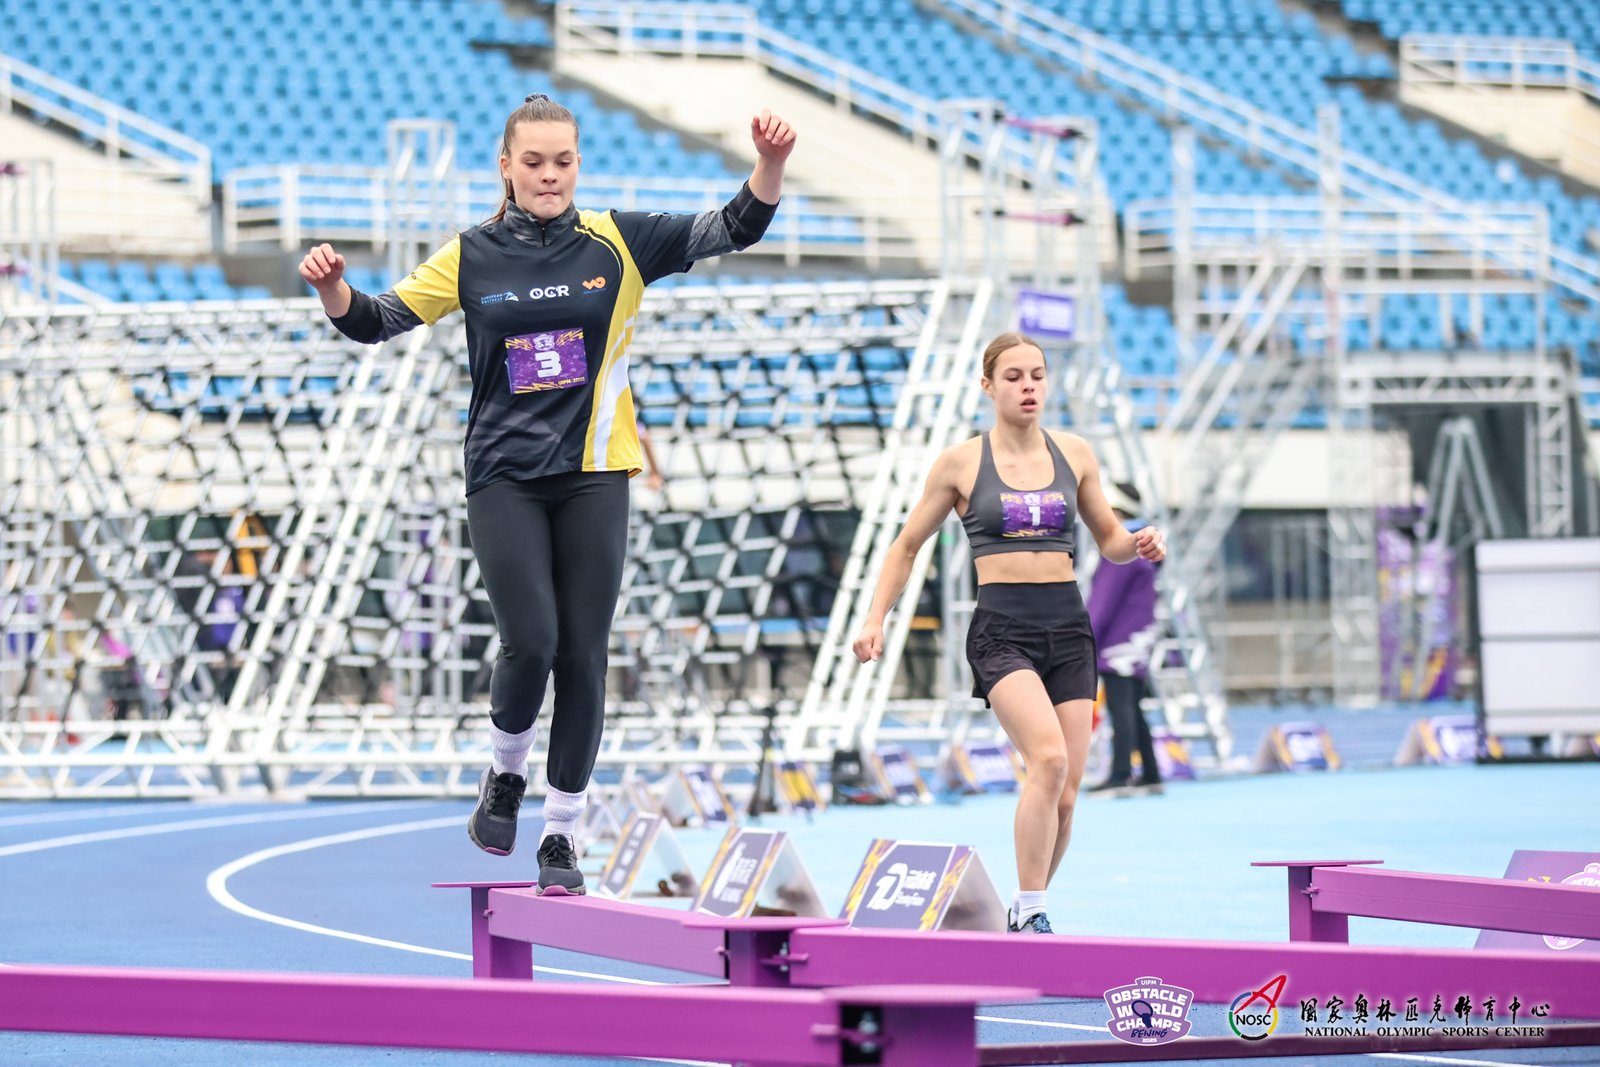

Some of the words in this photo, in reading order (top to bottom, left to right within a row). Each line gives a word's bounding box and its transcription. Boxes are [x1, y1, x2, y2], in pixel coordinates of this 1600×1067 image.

[529, 285, 570, 300] OCR
[534, 351, 562, 378] 3
[1028, 506, 1040, 527] 1
